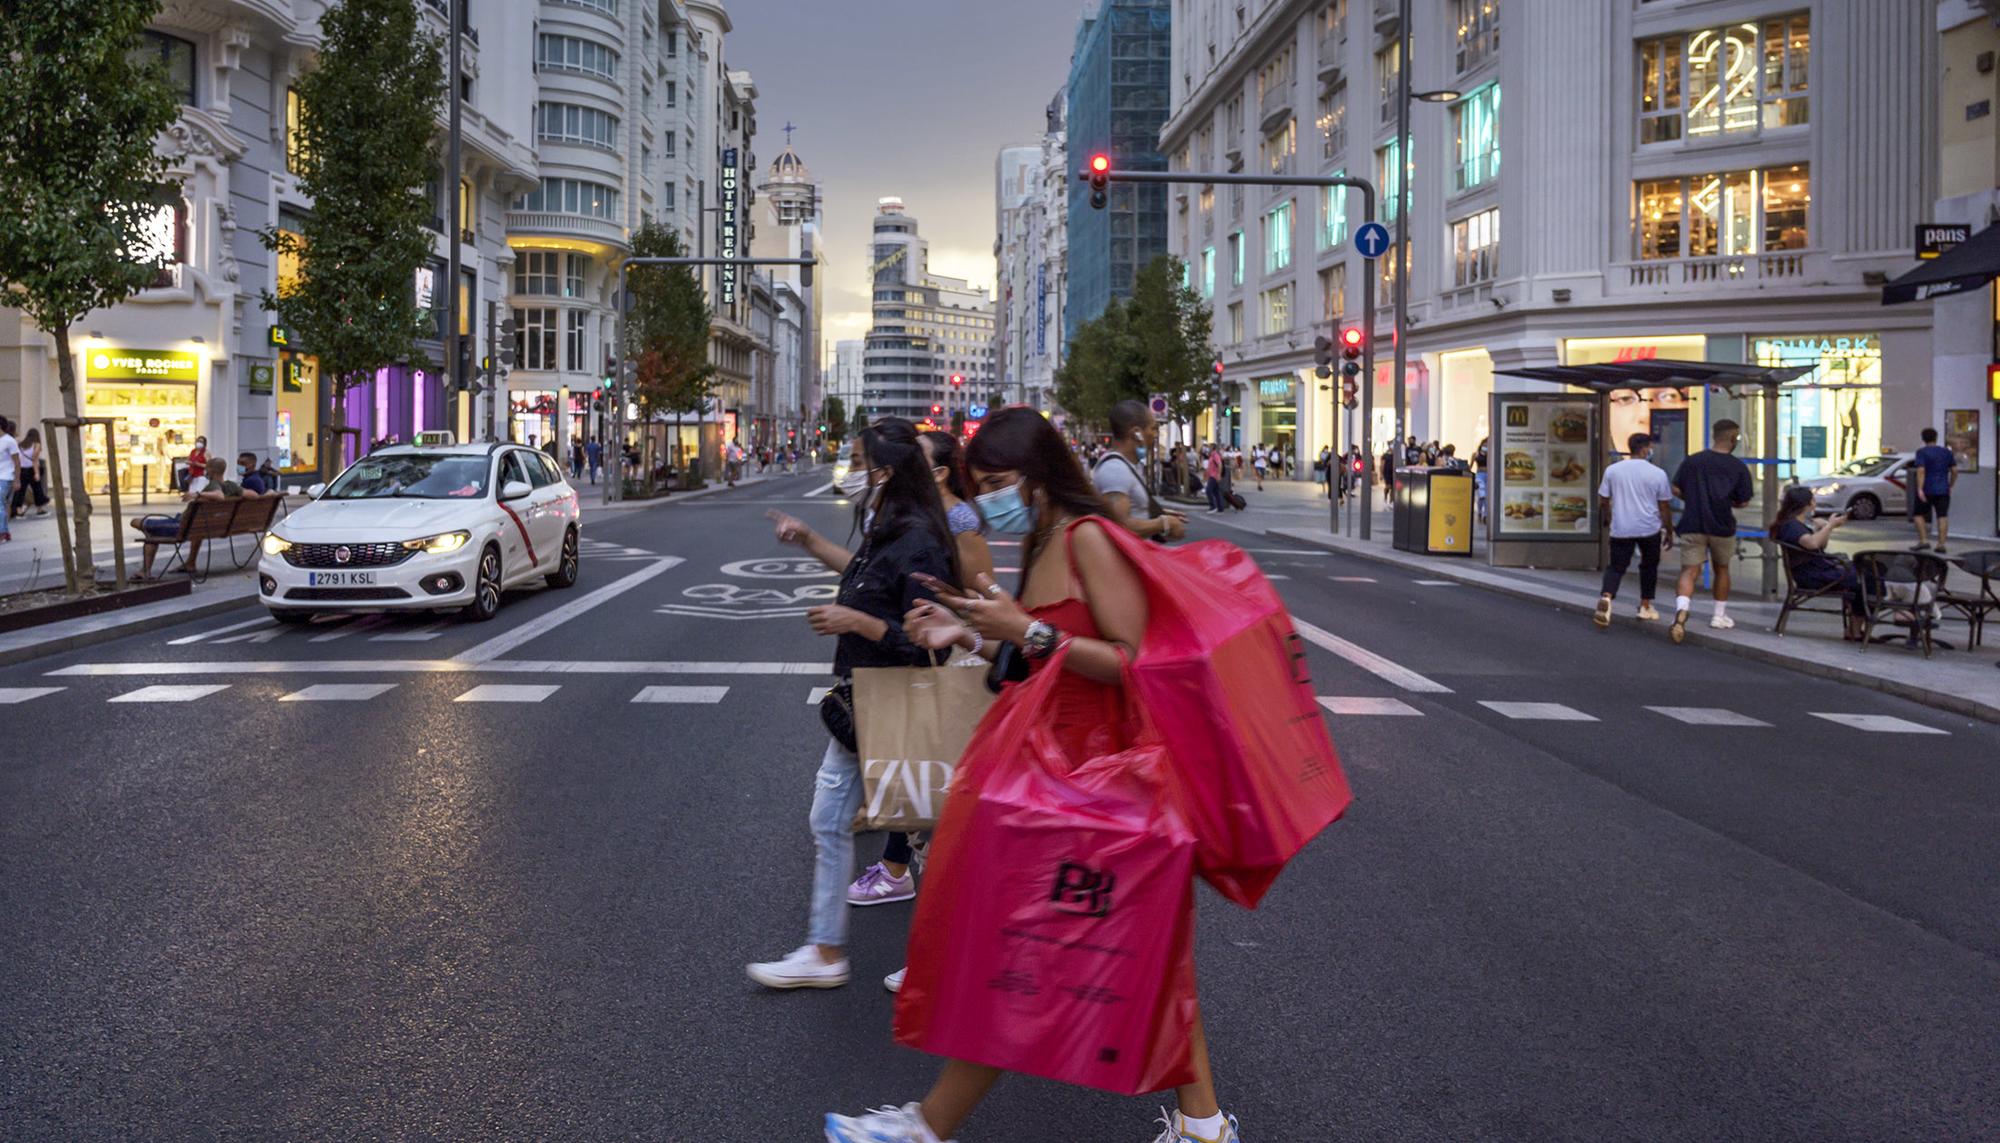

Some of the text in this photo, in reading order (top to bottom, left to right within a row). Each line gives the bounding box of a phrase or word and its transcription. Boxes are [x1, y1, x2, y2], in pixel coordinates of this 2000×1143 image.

[722, 167, 736, 222] HOTEL
[1925, 228, 1966, 247] pans
[111, 357, 194, 370] YVES ROCHER
[423, 433, 441, 445] TAXI
[317, 572, 375, 585] 2791 KSL
